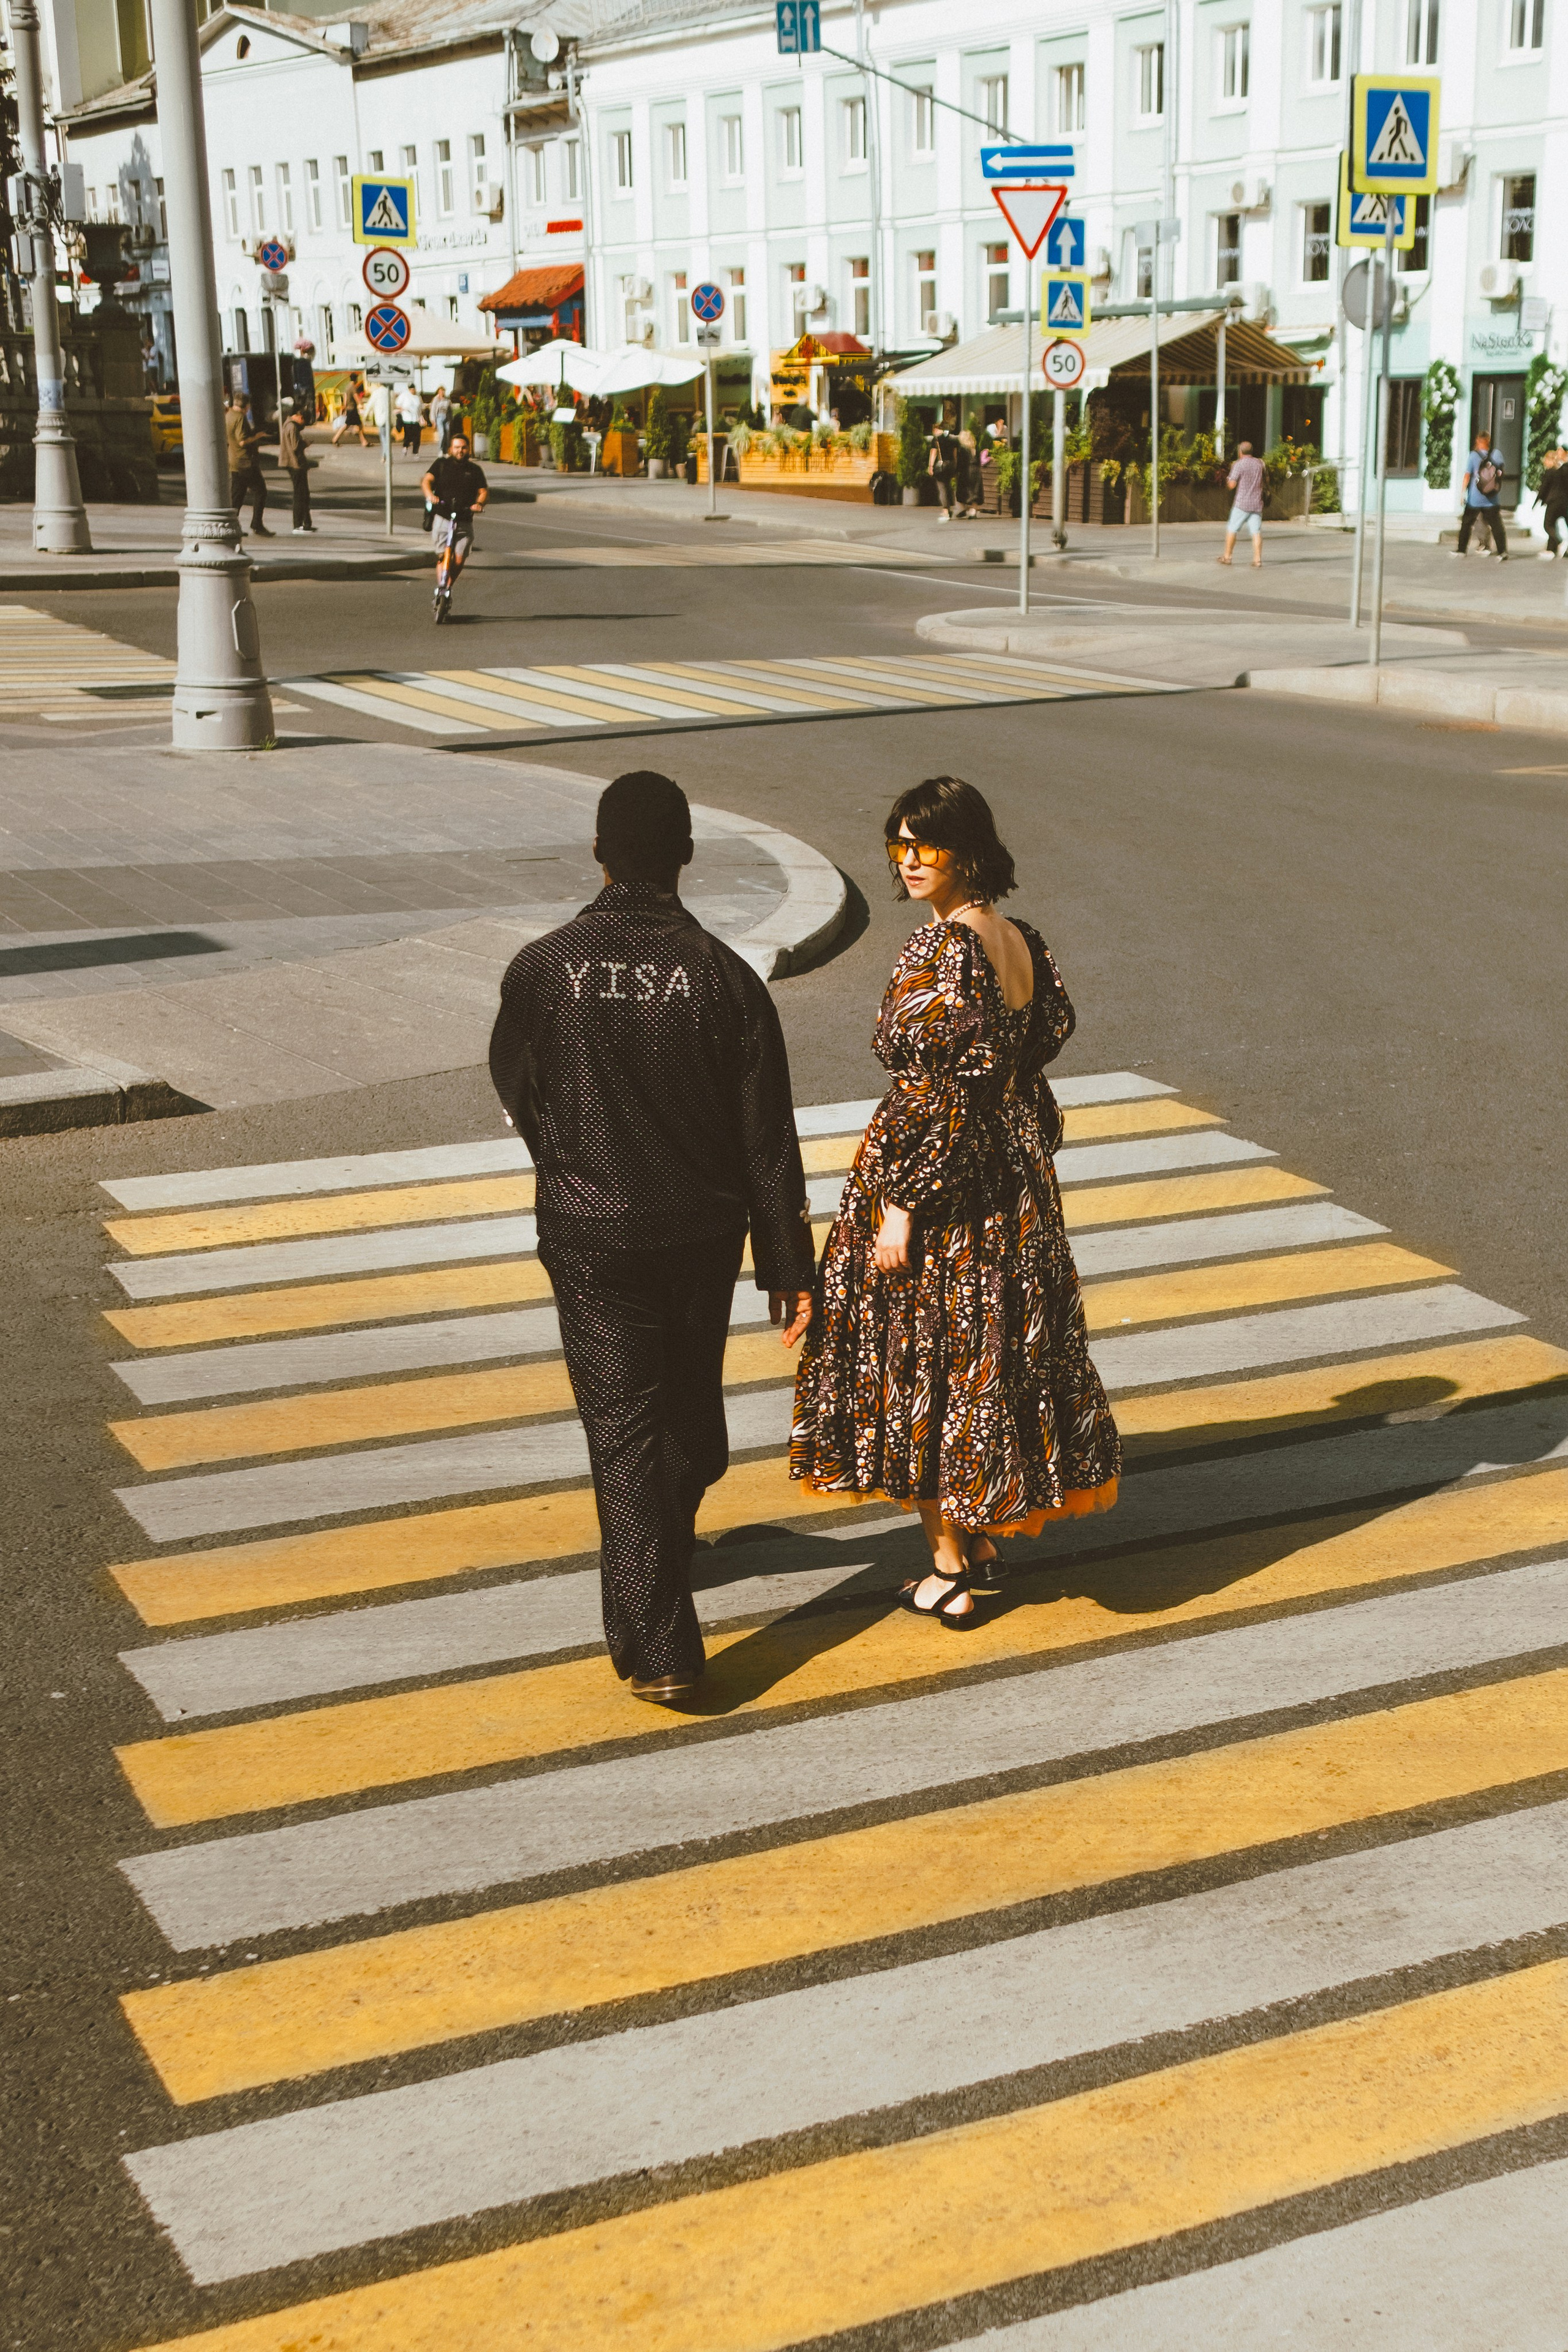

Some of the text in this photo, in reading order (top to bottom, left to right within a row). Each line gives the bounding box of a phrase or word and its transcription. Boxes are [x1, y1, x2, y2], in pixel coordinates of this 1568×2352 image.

[374, 263, 399, 283] 50
[1053, 354, 1076, 373] 50
[565, 961, 691, 1002] YISA
